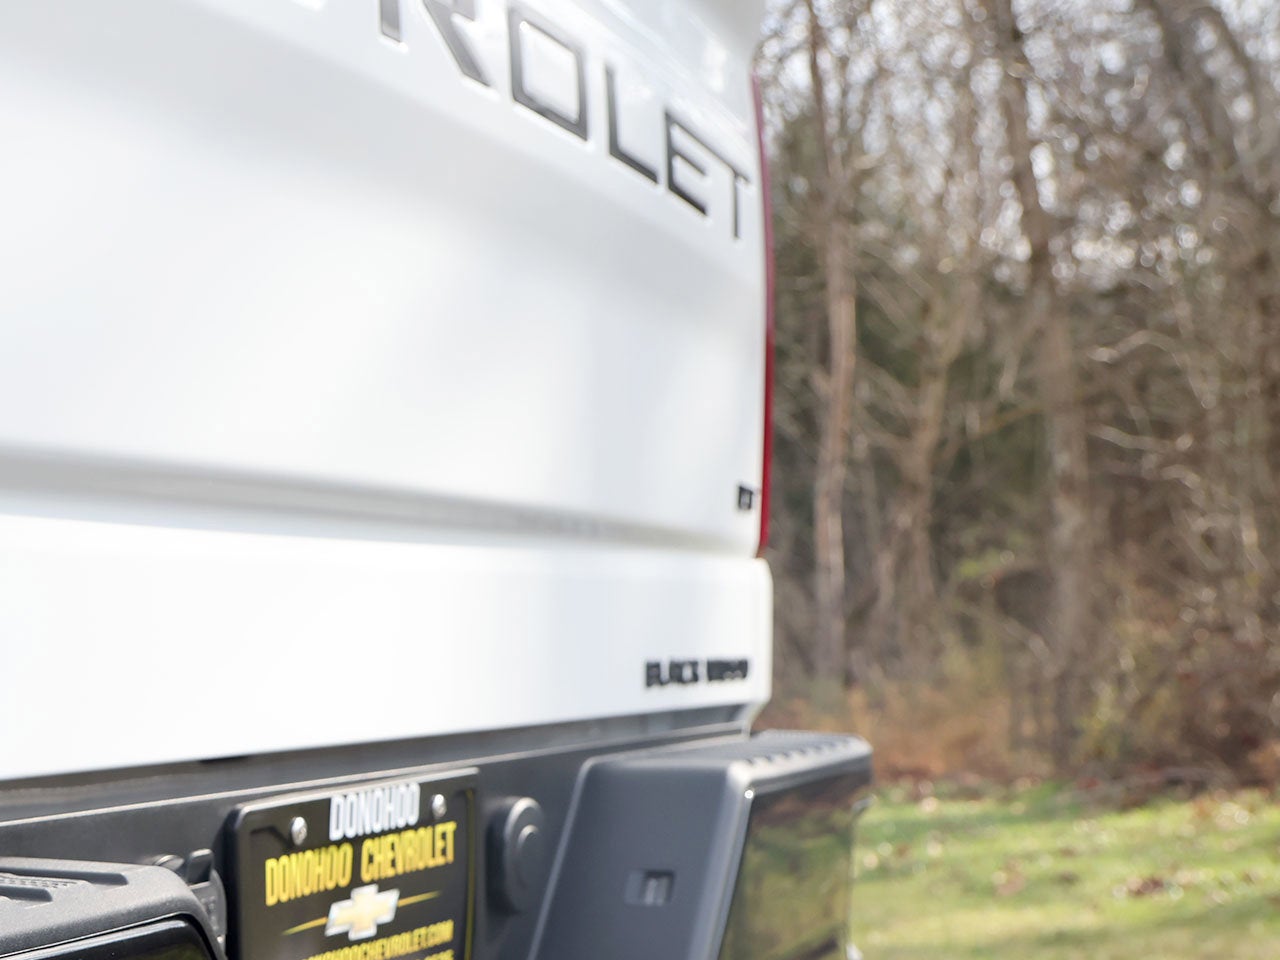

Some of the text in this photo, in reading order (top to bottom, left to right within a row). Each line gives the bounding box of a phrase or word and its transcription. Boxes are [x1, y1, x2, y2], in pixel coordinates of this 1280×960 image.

[330, 783, 420, 841] DONOHOO
[265, 821, 457, 906] DONOHOO CHEVROLET
